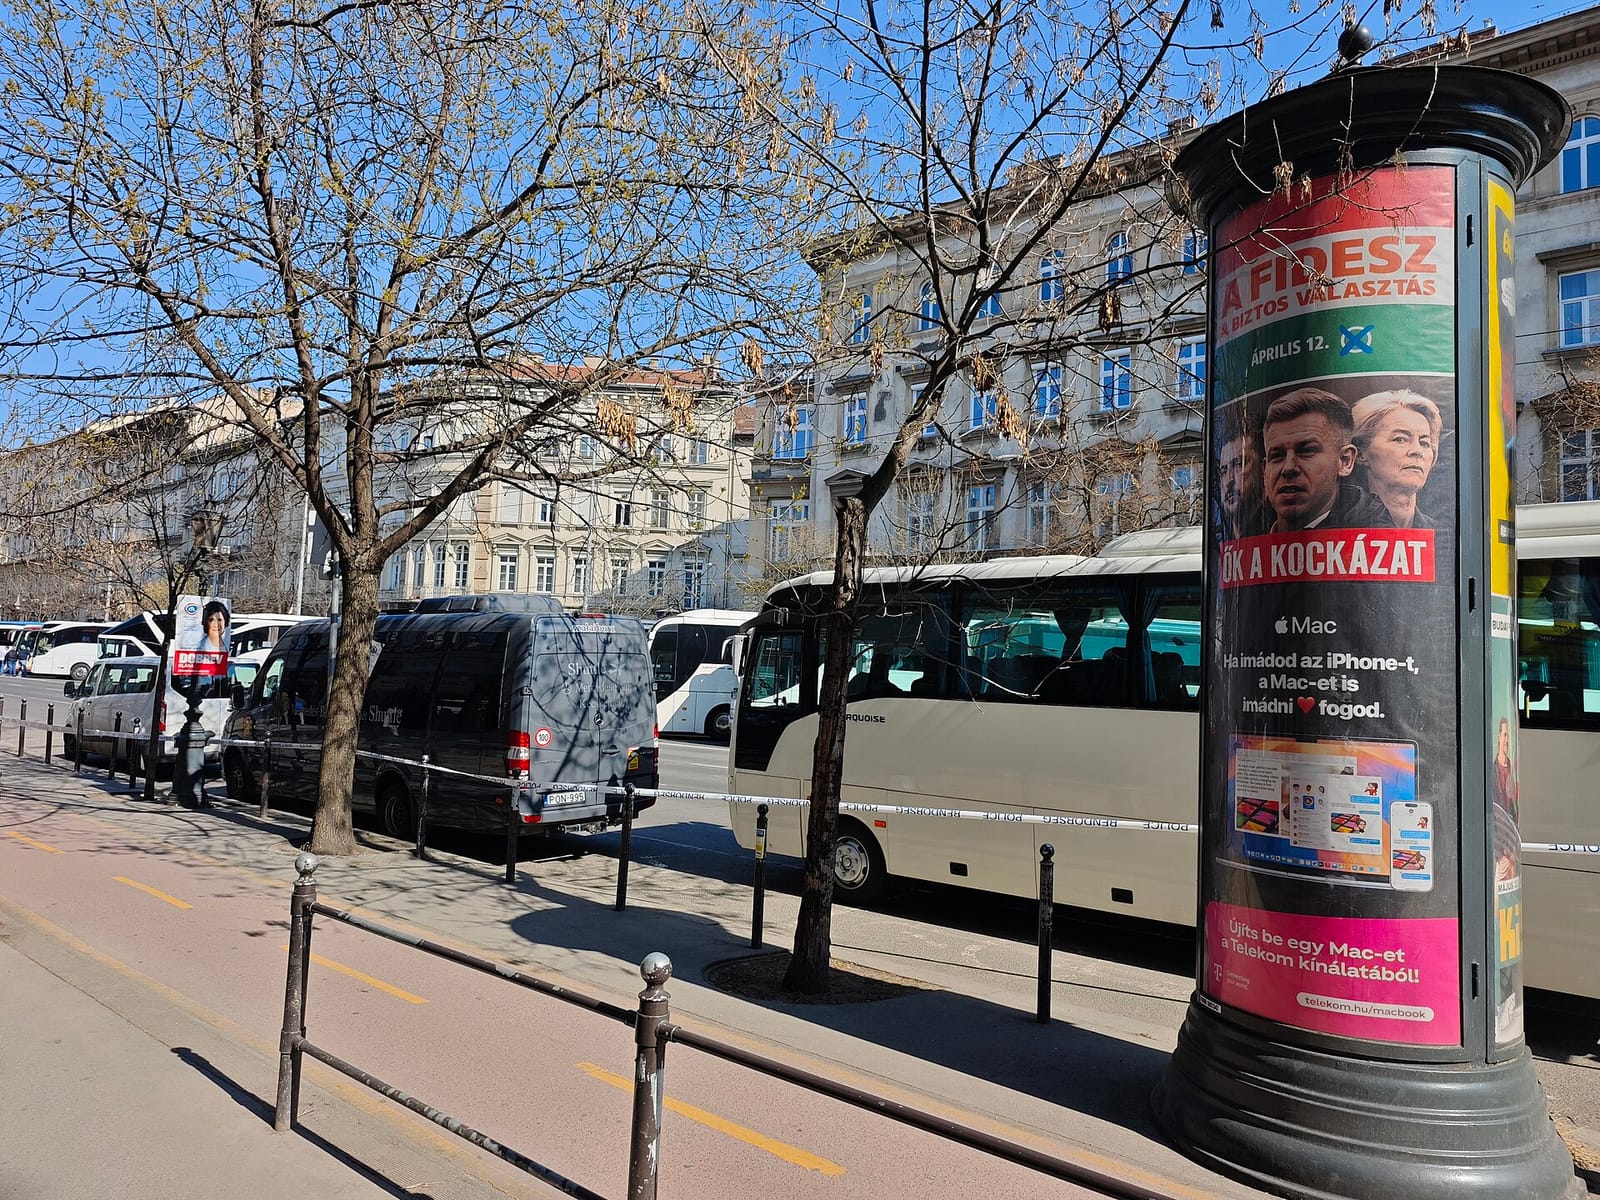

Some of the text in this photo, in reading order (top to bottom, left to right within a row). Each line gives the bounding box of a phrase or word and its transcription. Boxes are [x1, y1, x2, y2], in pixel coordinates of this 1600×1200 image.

[1221, 235, 1437, 318] A FIDESZ
[1231, 295, 1288, 333] BIZTOS
[1251, 335, 1330, 367] ÁPRILIS 12.
[1222, 533, 1428, 583] ŐK A KOCKÁZAT
[1291, 616, 1337, 634] Mac
[178, 652, 223, 665] DOBREV
[1223, 651, 1420, 675] Ha imádod az iPhone-t,
[1258, 673, 1360, 692] a Mac-et is
[1242, 696, 1385, 720] imádni fogod.
[538, 732, 549, 740] 100
[844, 803, 879, 813] POLICE
[982, 811, 1023, 822] POLICE
[1142, 821, 1189, 832] POLICE
[1549, 843, 1600, 853] OLICE
[1229, 917, 1405, 963] Újíts be egy Mac-et
[1221, 938, 1420, 983] a Telekom kínálatából!
[1304, 996, 1426, 1019] telekom.hu/macbook
